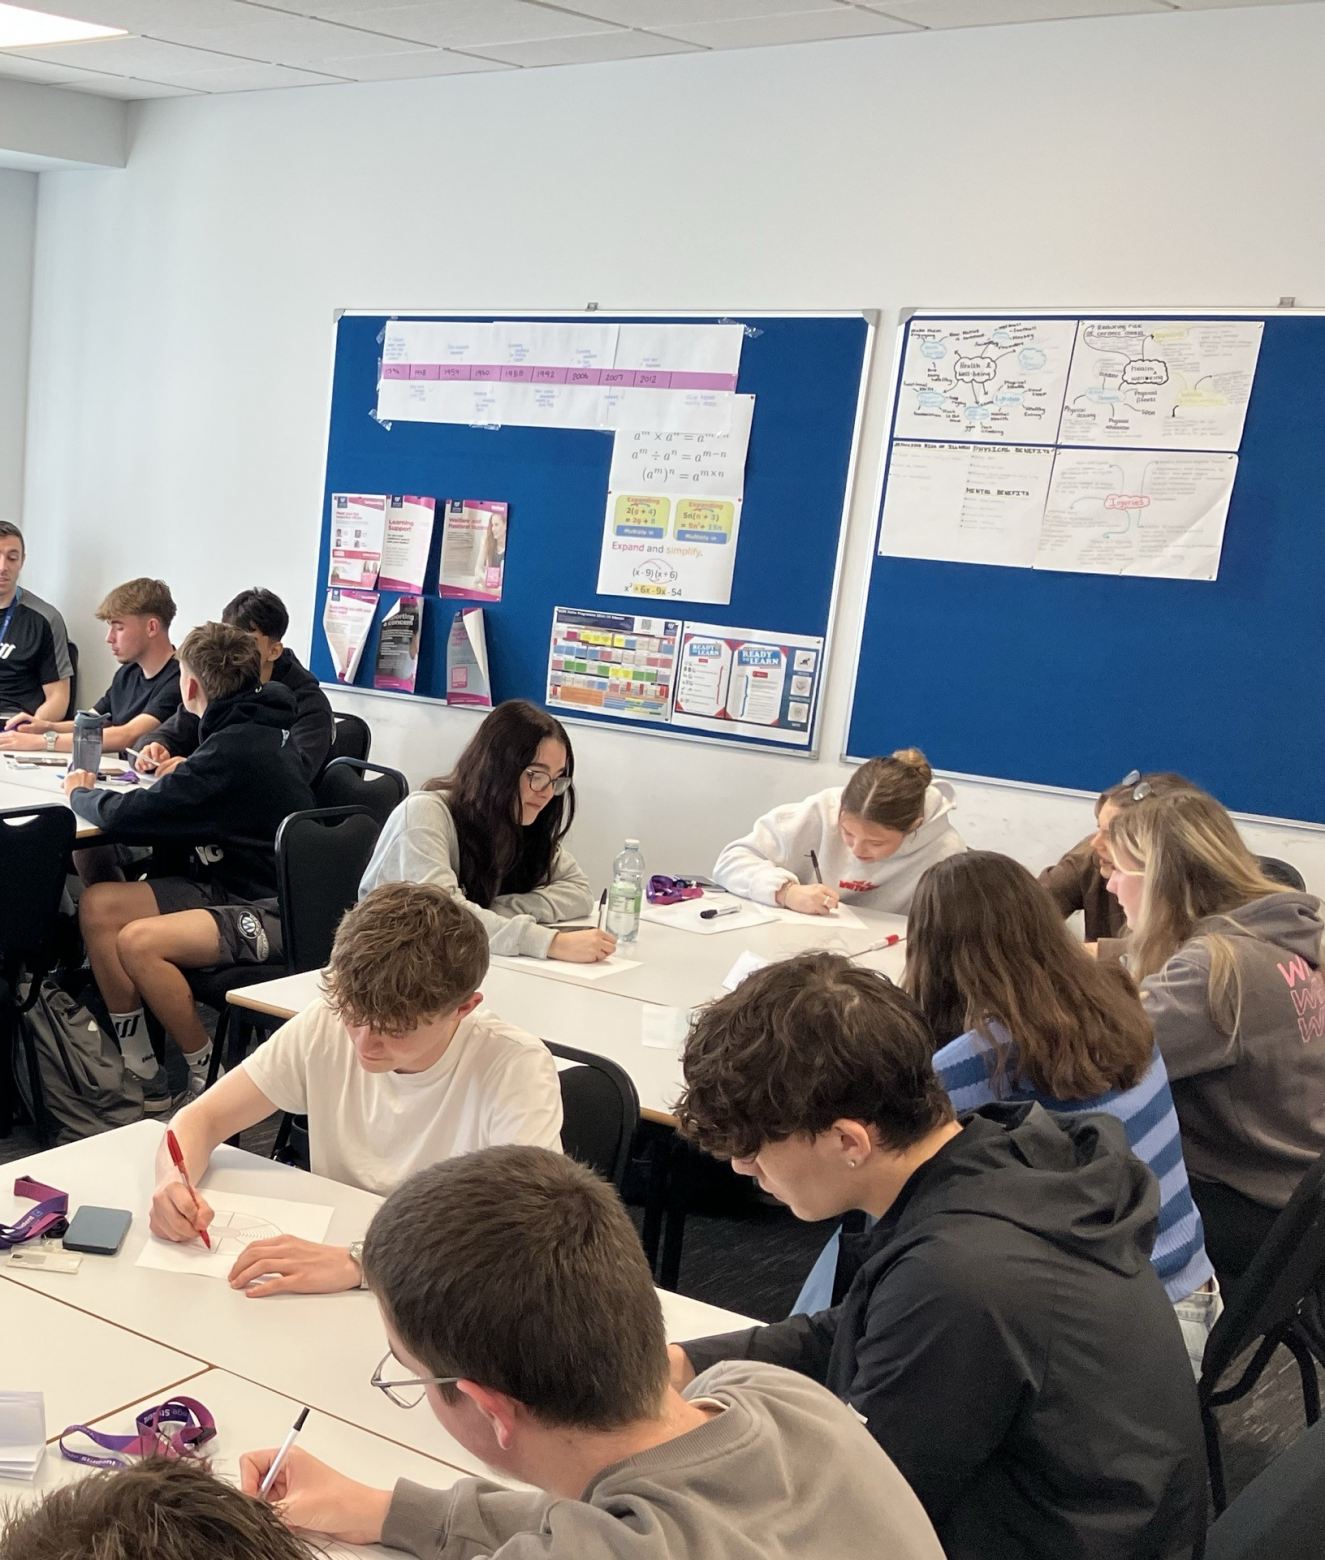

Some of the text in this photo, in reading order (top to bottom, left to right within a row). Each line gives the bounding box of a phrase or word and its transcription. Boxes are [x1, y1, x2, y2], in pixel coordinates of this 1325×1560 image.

[572, 372, 589, 381] 2006
[605, 373, 623, 382] 2007
[640, 375, 656, 383] 2012
[1109, 499, 1144, 509] Injuries
[612, 541, 703, 558] Expand and simplify.
[742, 650, 772, 658] READY
